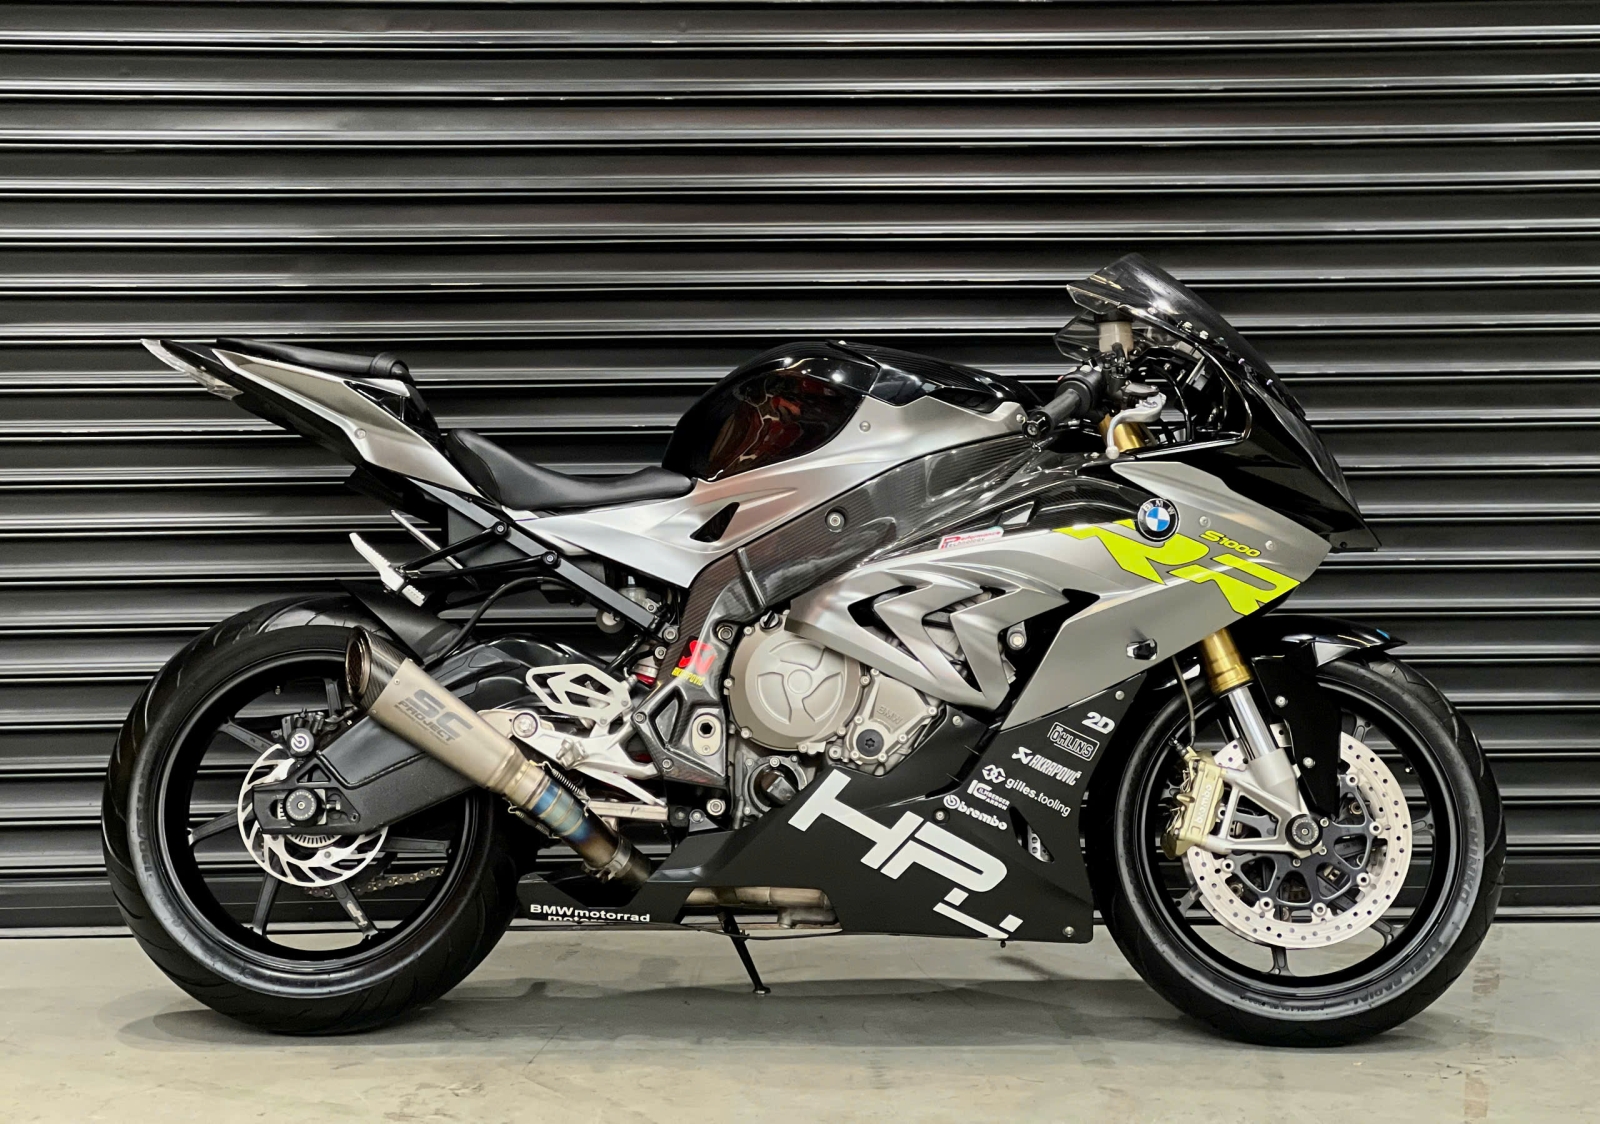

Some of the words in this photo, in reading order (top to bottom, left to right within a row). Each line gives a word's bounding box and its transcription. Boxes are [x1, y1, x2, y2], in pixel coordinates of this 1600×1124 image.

[1142, 500, 1175, 515] BMW
[1199, 530, 1261, 557] S1000
[397, 700, 456, 741] PROJECT
[404, 688, 474, 739] SC
[1082, 711, 1116, 735] 2D
[1005, 776, 1072, 817] gilles.tooling
[1195, 783, 1212, 824] brembo
[957, 800, 1008, 831] brembo
